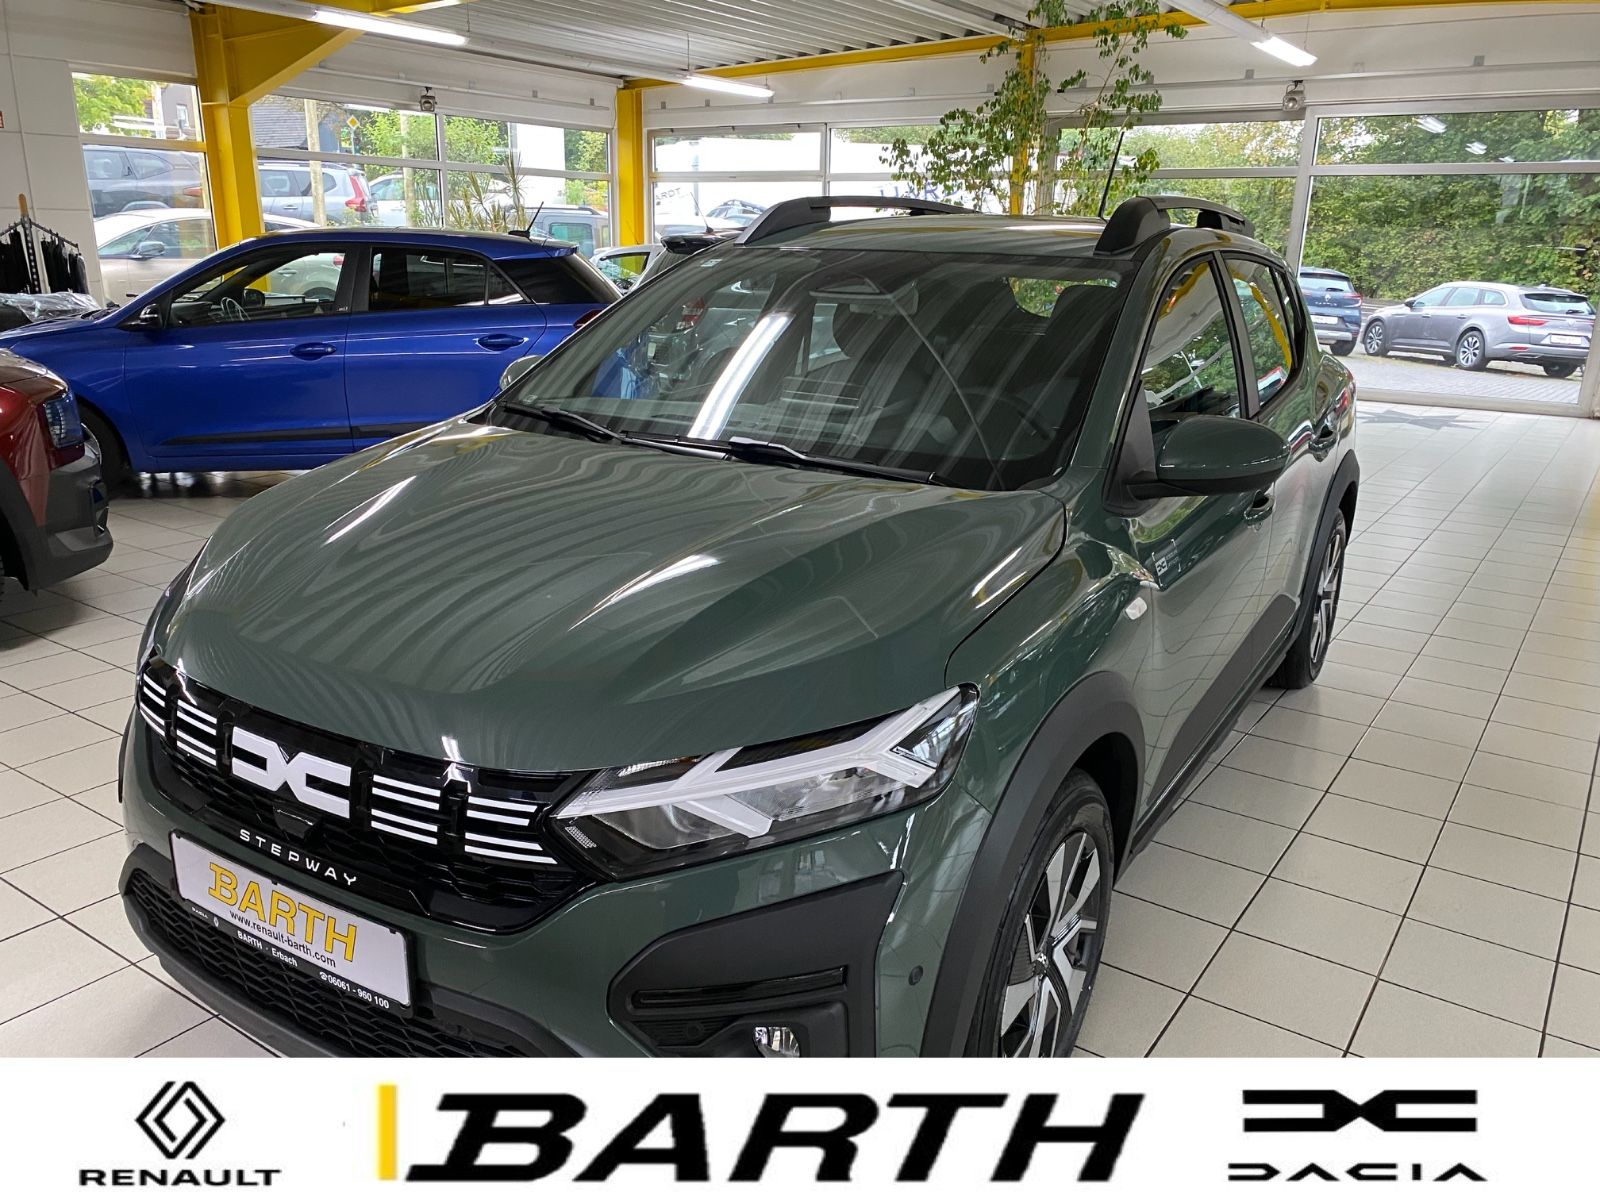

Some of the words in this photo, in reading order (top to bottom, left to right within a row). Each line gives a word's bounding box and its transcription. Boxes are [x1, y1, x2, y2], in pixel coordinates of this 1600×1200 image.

[239, 828, 357, 885] STEPWAY
[207, 861, 358, 963] BARTH
[229, 910, 336, 967] www.renault-barth.com
[237, 930, 263, 950] BARTH
[271, 947, 298, 967] Erbach
[327, 974, 351, 992] 06061
[357, 988, 372, 1002] 960
[374, 995, 389, 1009] 100
